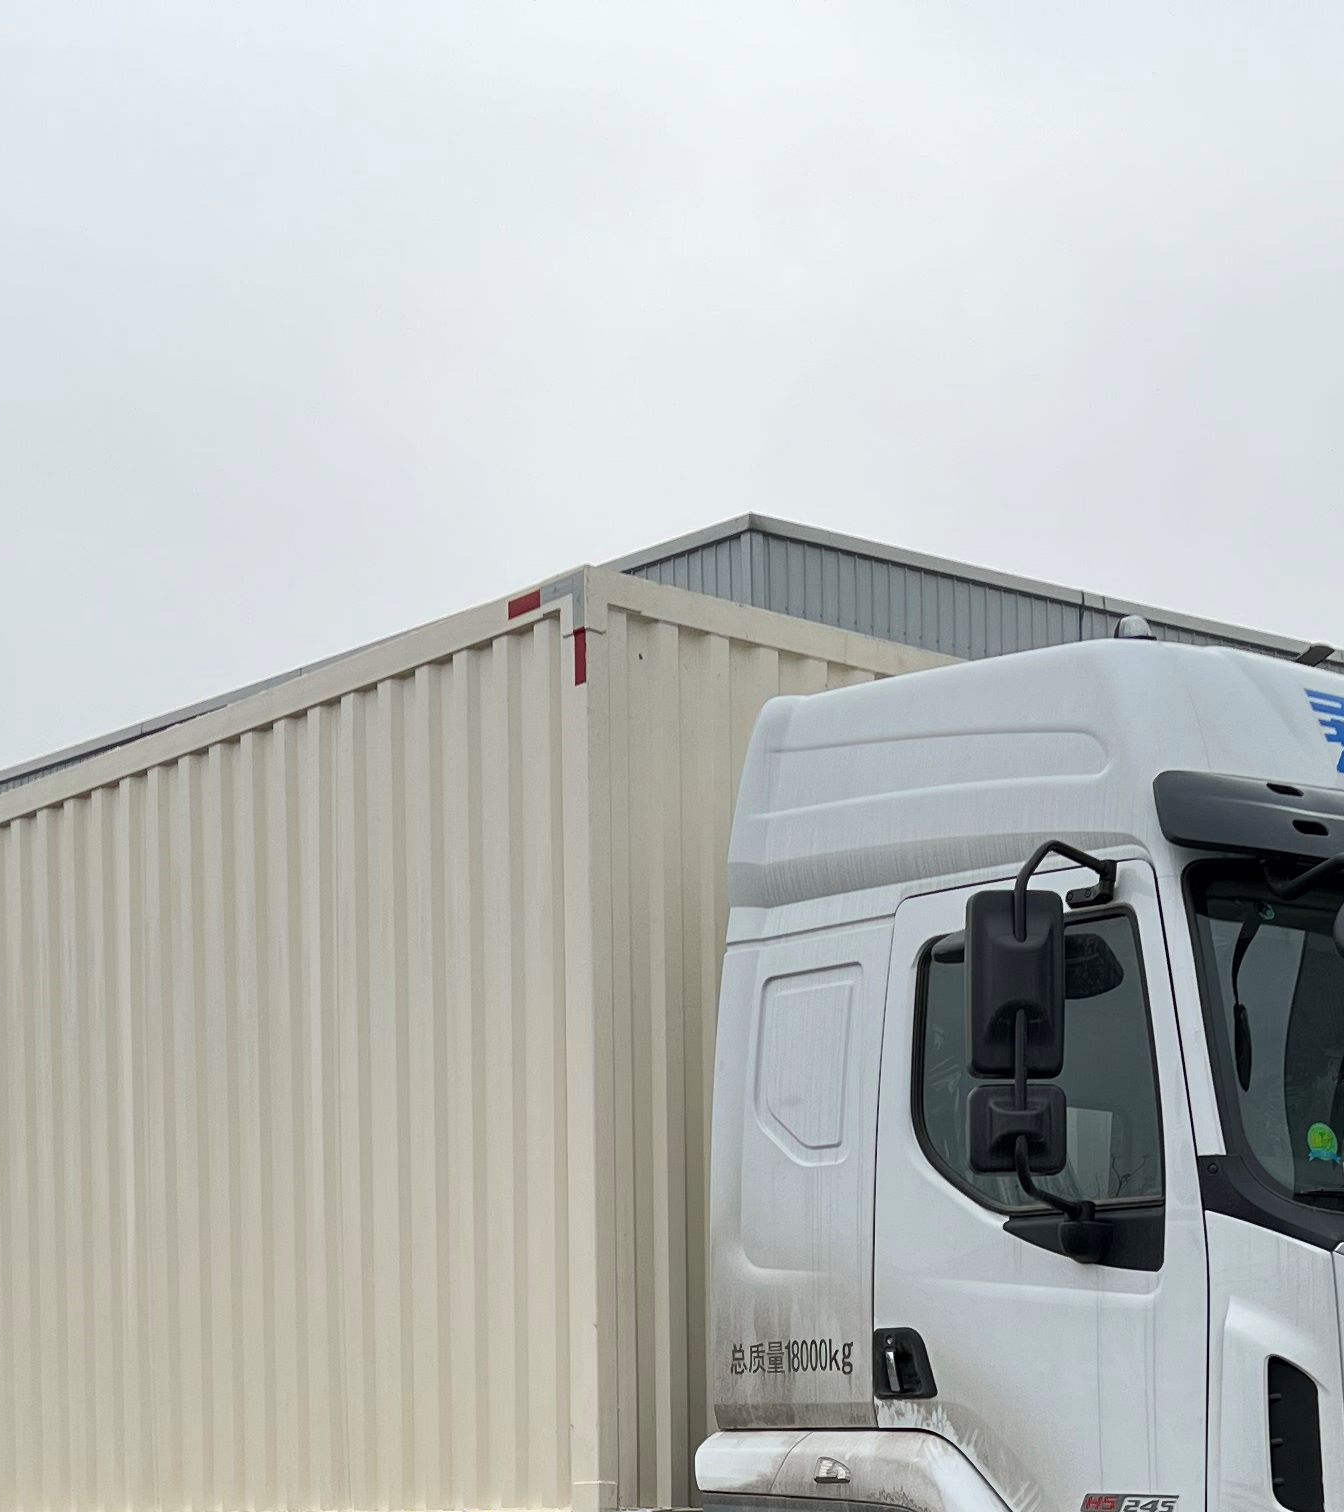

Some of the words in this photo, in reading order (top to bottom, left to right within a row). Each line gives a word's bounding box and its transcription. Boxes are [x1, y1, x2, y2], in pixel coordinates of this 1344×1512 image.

[731, 1338, 853, 1375] 总质量18000kg
[1123, 1499, 1176, 1512] 245
